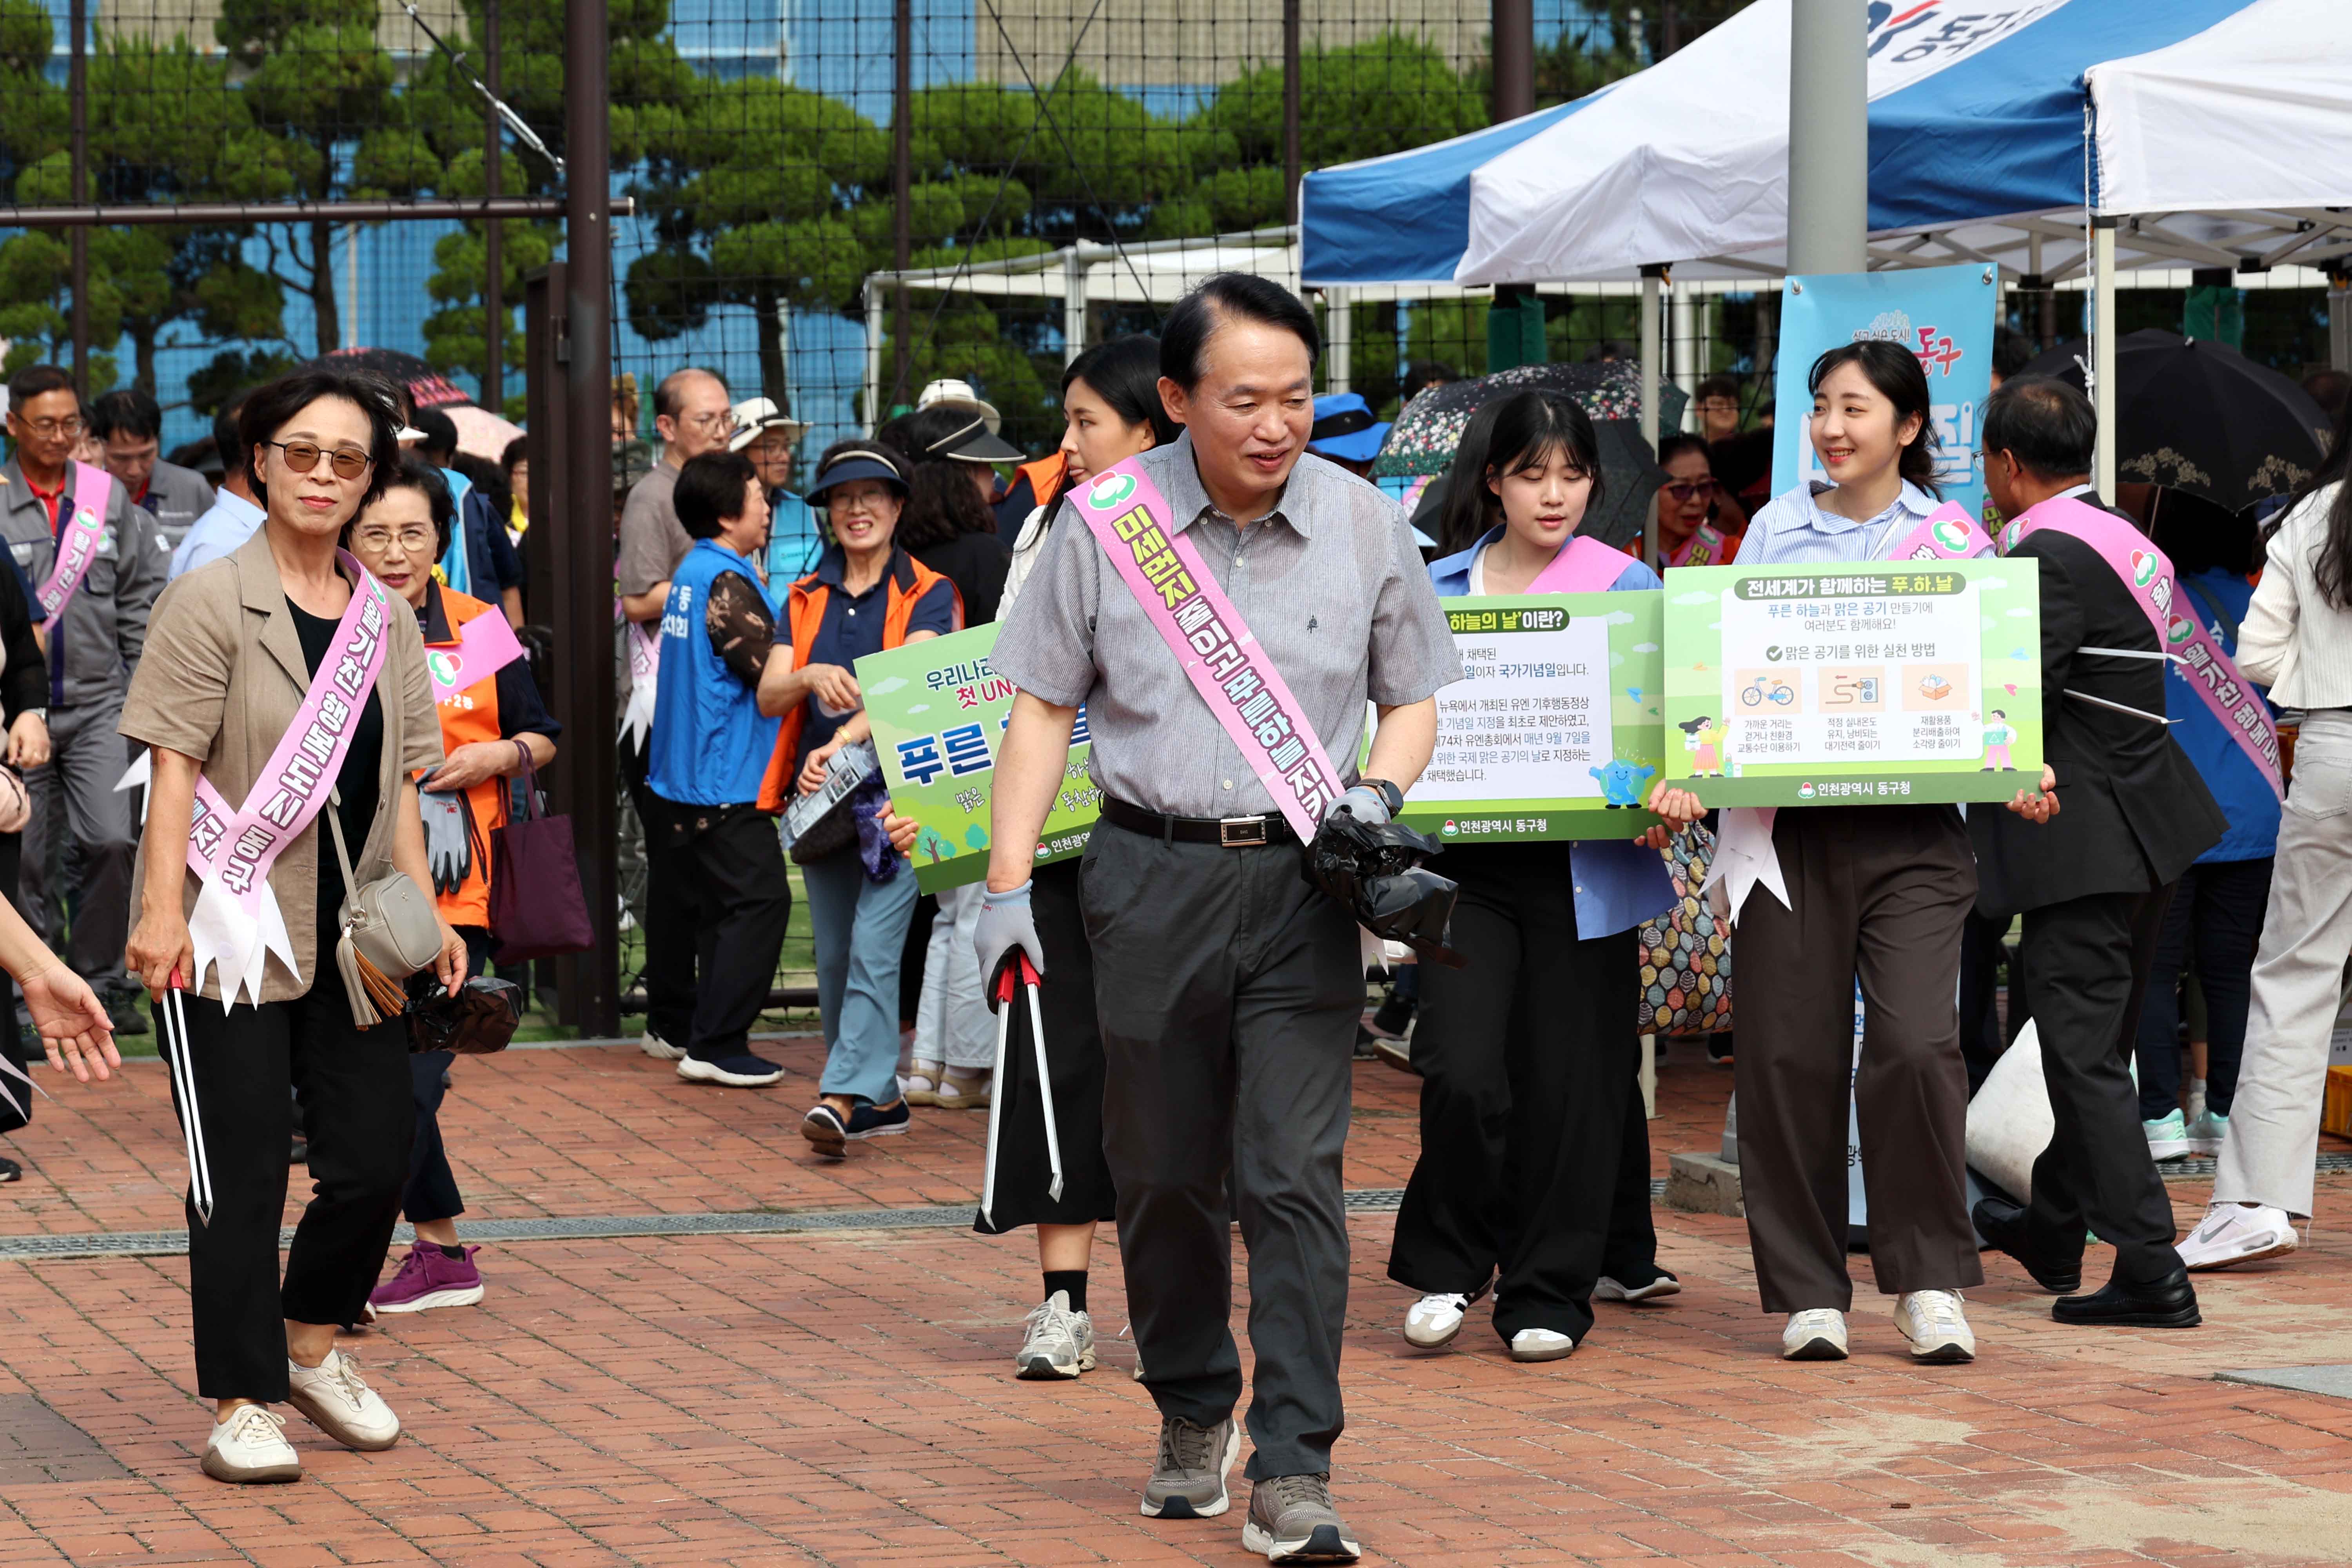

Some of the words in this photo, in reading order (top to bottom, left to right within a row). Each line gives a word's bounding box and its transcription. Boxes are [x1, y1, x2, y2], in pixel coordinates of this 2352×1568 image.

[1891, 329, 1910, 342] 도시!
[1913, 328, 1962, 376] 동구
[1748, 579, 1815, 597] 전세계가
[1820, 577, 1886, 595] 함께하는
[1892, 575, 1953, 593] 푸.하.날
[1768, 604, 1791, 618] 푸른
[1796, 604, 1831, 617] 하늘과
[1835, 603, 1858, 616] 맑은
[1863, 601, 1886, 615] 공기
[1891, 601, 1932, 614] 만들기에
[1450, 613, 1497, 630] 하늘의
[1805, 620, 1846, 632] 여러분도
[1850, 619, 1895, 631] 함께해요!
[334, 594, 384, 700] 활기찬
[1467, 648, 1496, 661] 채택된
[1786, 646, 1809, 660] 맑은
[1814, 645, 1850, 659] 공기를
[1855, 644, 1879, 658] 위한
[1884, 644, 1906, 658] 실천
[1912, 643, 1935, 657] 방법
[1111, 504, 1200, 610] 미세먼지
[1174, 596, 1249, 683] 줄이고
[1286, 757, 1336, 823] 지키
[1499, 663, 1588, 678] 국가기념일입니다.
[2183, 641, 2243, 710] 활기찬
[956, 687, 978, 709] 첫
[1439, 699, 1476, 713] 뉴욕에서
[1480, 699, 1507, 711] 개최된
[1511, 698, 1529, 711] 유엔
[1533, 697, 1589, 710] 기후행동정상
[1446, 717, 1473, 730] 기념일
[1477, 716, 1505, 729] 지정을
[1508, 716, 1536, 728] 최초로
[1539, 714, 1589, 727] 제안하였고,
[1745, 720, 1767, 729] 가까운
[1770, 719, 1792, 729] 거리는
[1828, 718, 1843, 727] 적정
[1846, 717, 1877, 727] 실내온도
[1921, 715, 1951, 725] 재활용품
[1465, 733, 1521, 746] 유엔총회에서
[1524, 733, 1543, 745] 매년
[1546, 732, 1562, 744] 9월
[1565, 731, 1590, 744] 7일을
[1746, 731, 1768, 741] 걷거나
[1770, 731, 1792, 740] 친환경
[1828, 730, 1844, 739] 유지,
[1847, 729, 1877, 739] 낭비되는
[1913, 727, 1960, 737] 분리배출하여
[1738, 743, 1768, 753] 교통수단
[1770, 742, 1800, 752] 이용하기
[1825, 741, 1855, 751] 대기전력
[1858, 740, 1880, 750] 줄이기
[1913, 739, 1935, 749] 소각량
[1938, 739, 1960, 748] 줄이기
[260, 689, 350, 830] 행복도시
[897, 724, 993, 785] 푸른
[1437, 752, 1456, 764] 위한
[1459, 752, 1477, 764] 국제
[1479, 751, 1498, 764] 맑은
[1501, 750, 1528, 763] 공기의
[1532, 750, 1550, 762] 날로
[1553, 749, 1590, 761] 지정하는
[1427, 769, 1486, 782] 채택했습니다.
[1818, 782, 1873, 796] 인천광역시
[1878, 781, 1910, 795] 동구청
[955, 787, 985, 813] 맑은
[1061, 786, 1104, 812] 동참하
[1461, 820, 1512, 833] 인천광역시
[1516, 819, 1546, 832] 동구청
[221, 823, 276, 895] 동구
